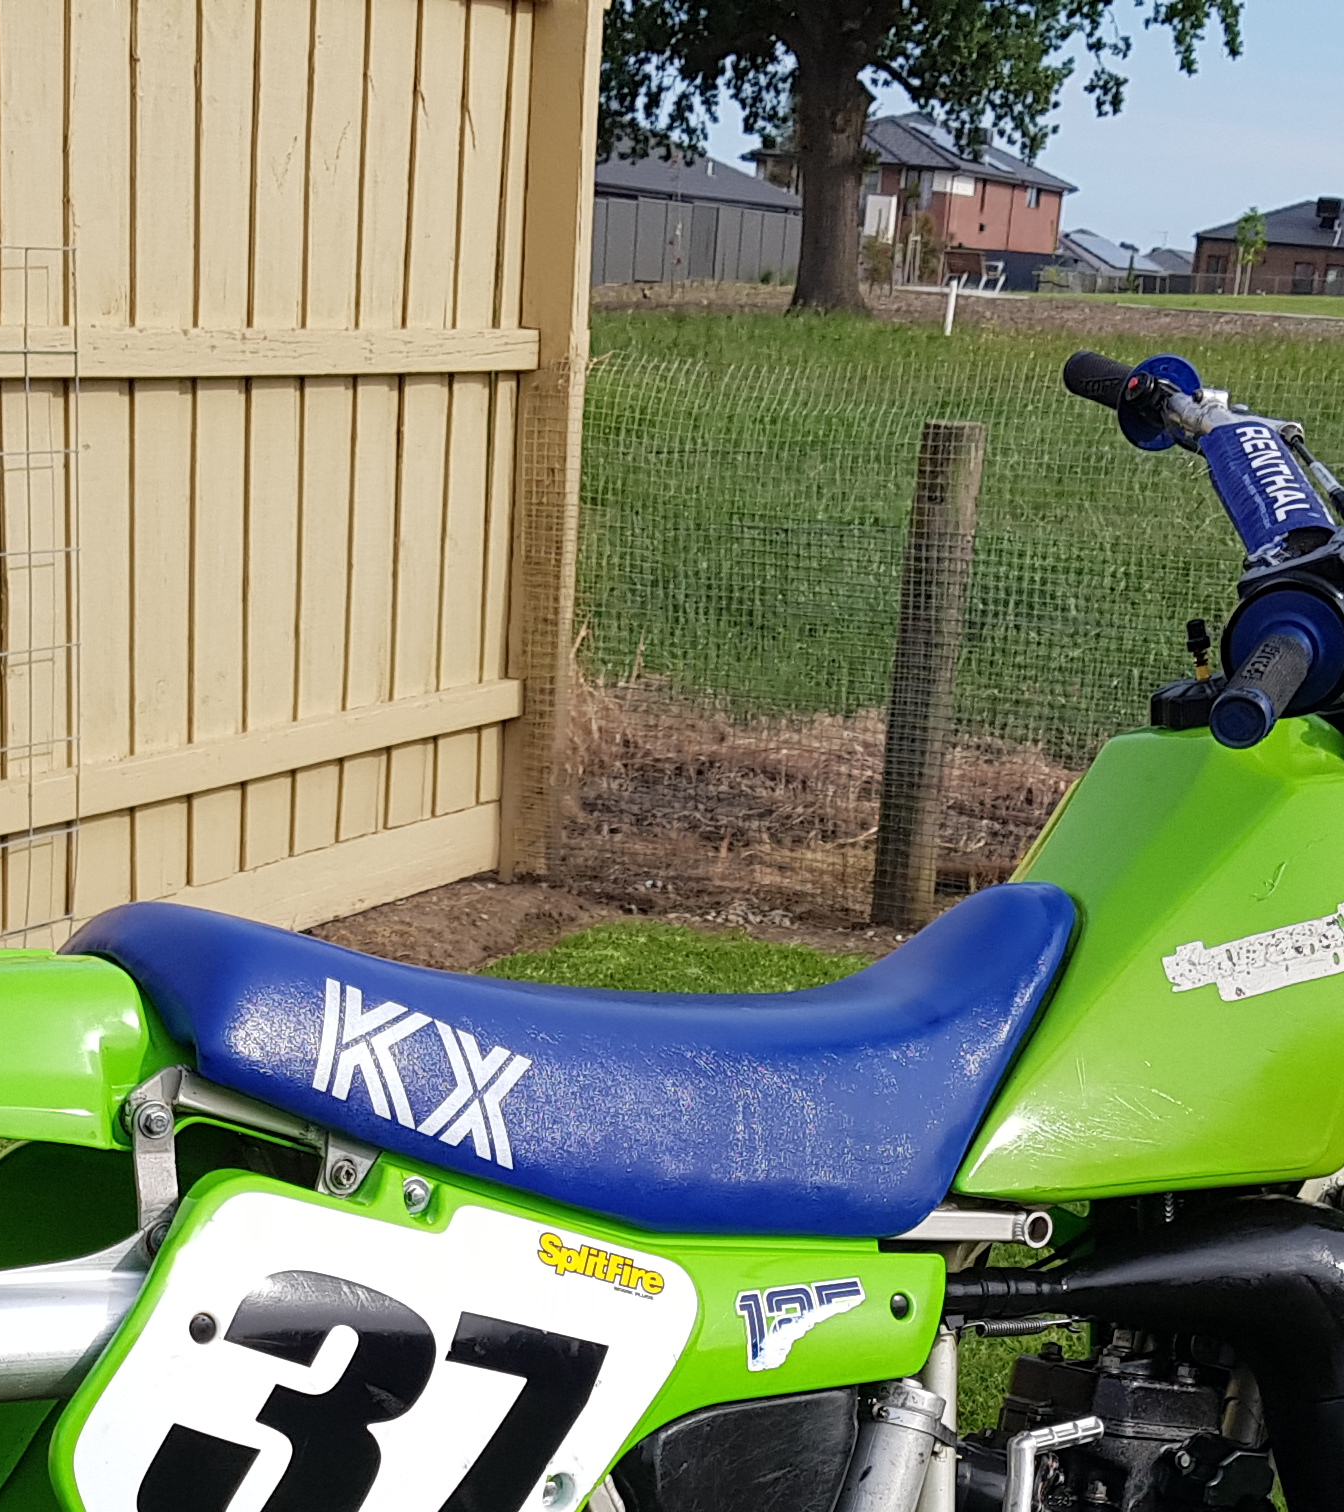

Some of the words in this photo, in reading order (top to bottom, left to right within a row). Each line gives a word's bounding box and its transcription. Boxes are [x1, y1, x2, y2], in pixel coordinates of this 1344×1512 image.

[1234, 425, 1311, 524] RENTHAL
[311, 976, 533, 1171] KX
[536, 1231, 666, 1296] SplitFire
